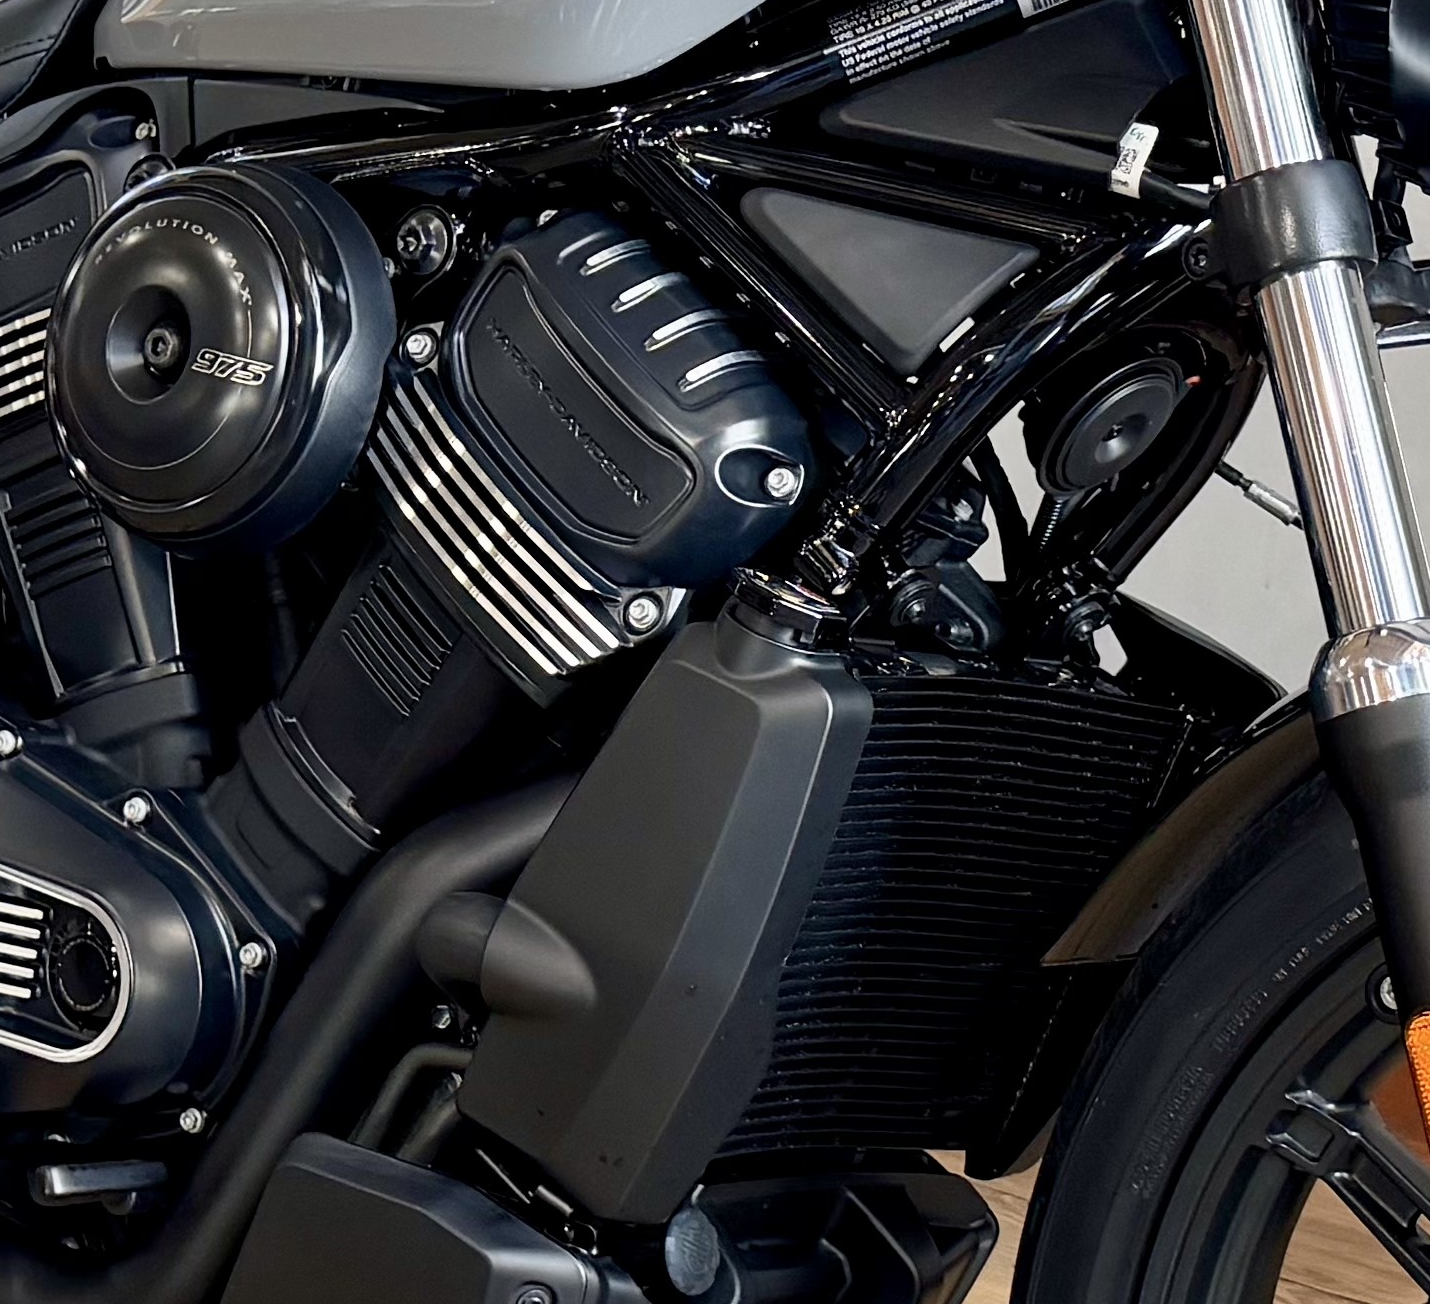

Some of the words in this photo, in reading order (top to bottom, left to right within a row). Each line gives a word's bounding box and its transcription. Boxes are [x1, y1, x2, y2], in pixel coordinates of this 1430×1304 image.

[856, 44, 884, 60] Federal
[886, 35, 909, 48] motor
[911, 23, 937, 38] vehicle
[939, 13, 963, 27] safety
[858, 34, 884, 49] vehicle
[886, 18, 922, 37] conforms
[855, 58, 876, 71] effect
[904, 40, 920, 51] date
[94, 218, 219, 265] REVOLUTION
[191, 347, 275, 386] 975
